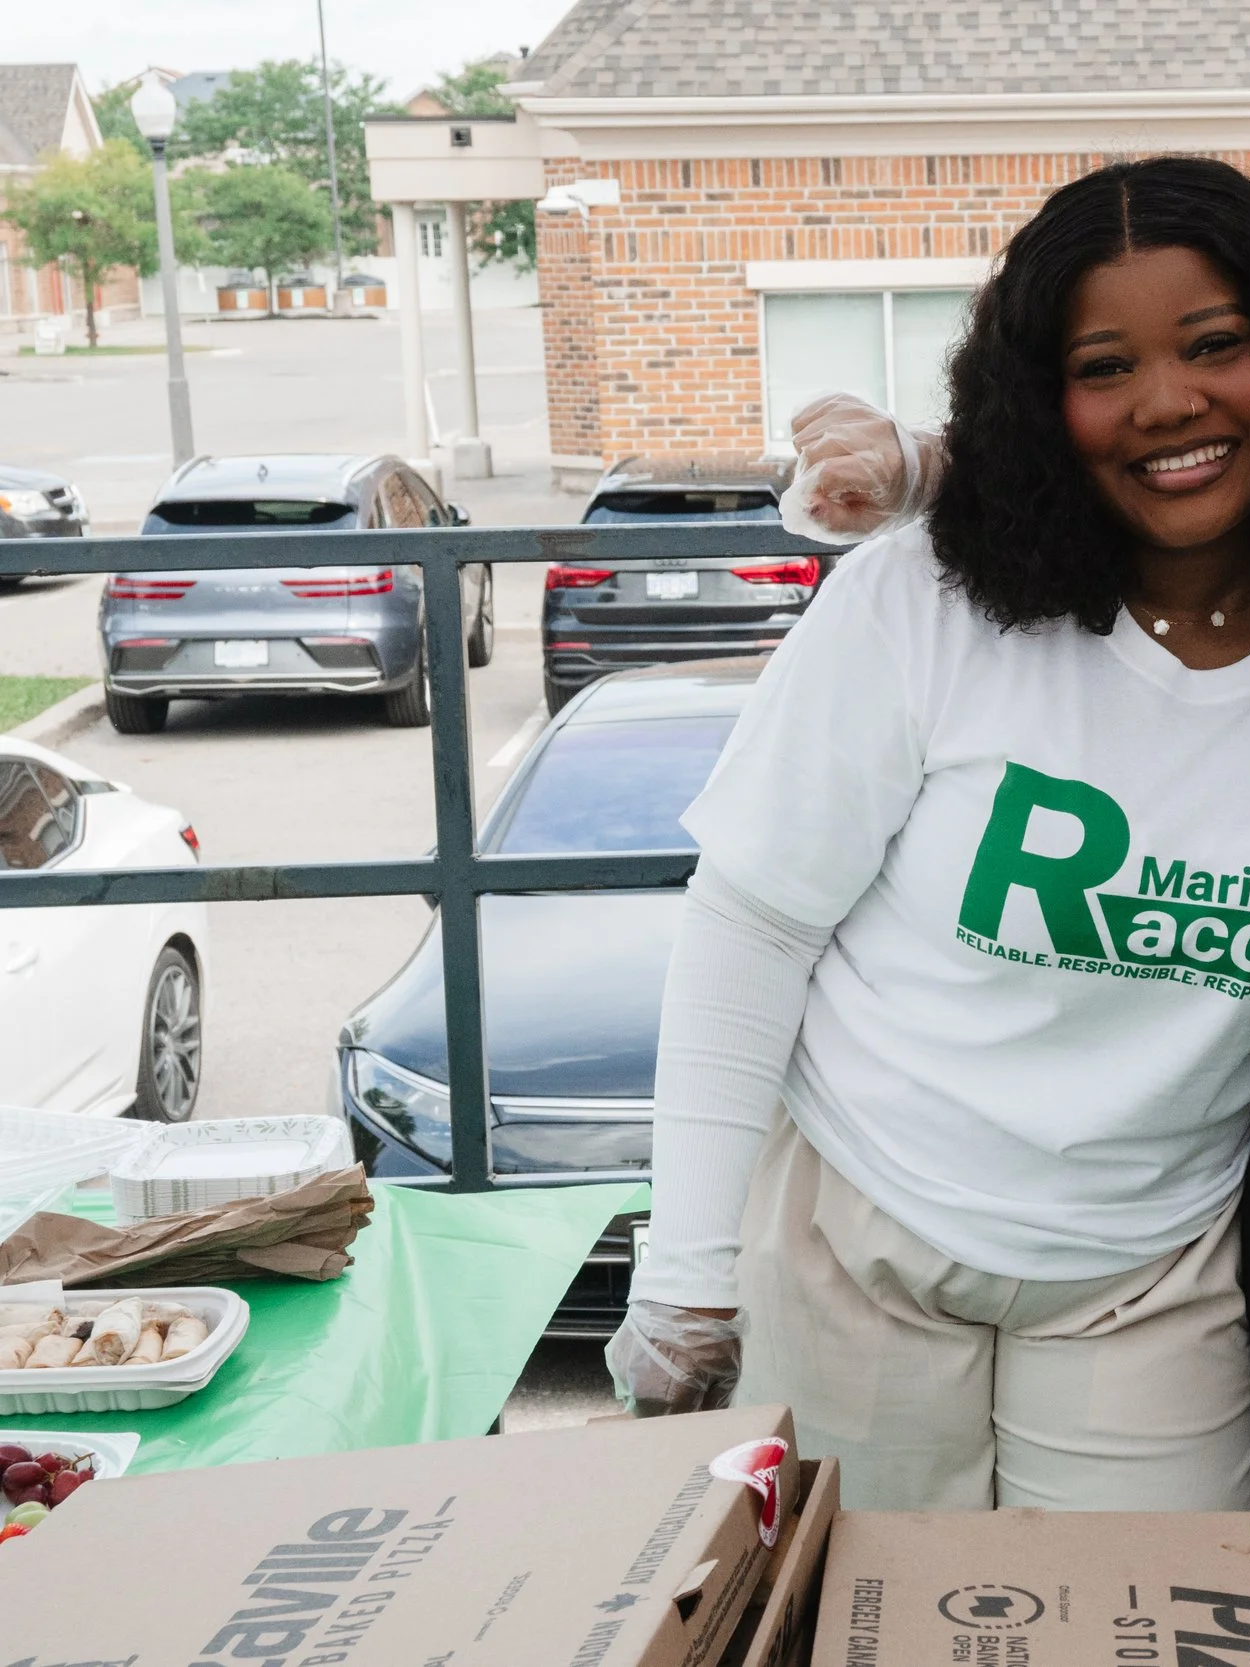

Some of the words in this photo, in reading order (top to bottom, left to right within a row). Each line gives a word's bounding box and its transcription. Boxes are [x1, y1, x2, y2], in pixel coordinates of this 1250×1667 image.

[955, 926, 1053, 969] RELIABLE.
[1057, 957, 1199, 987] RESPONSIBLE.
[620, 1502, 699, 1586] AUTHENTICALLY
[187, 1507, 410, 1667] aville
[298, 1590, 396, 1667] BAKED
[367, 1518, 455, 1582] PIZZA
[850, 1577, 884, 1634] FIERCELY
[951, 1634, 972, 1663] OPEN
